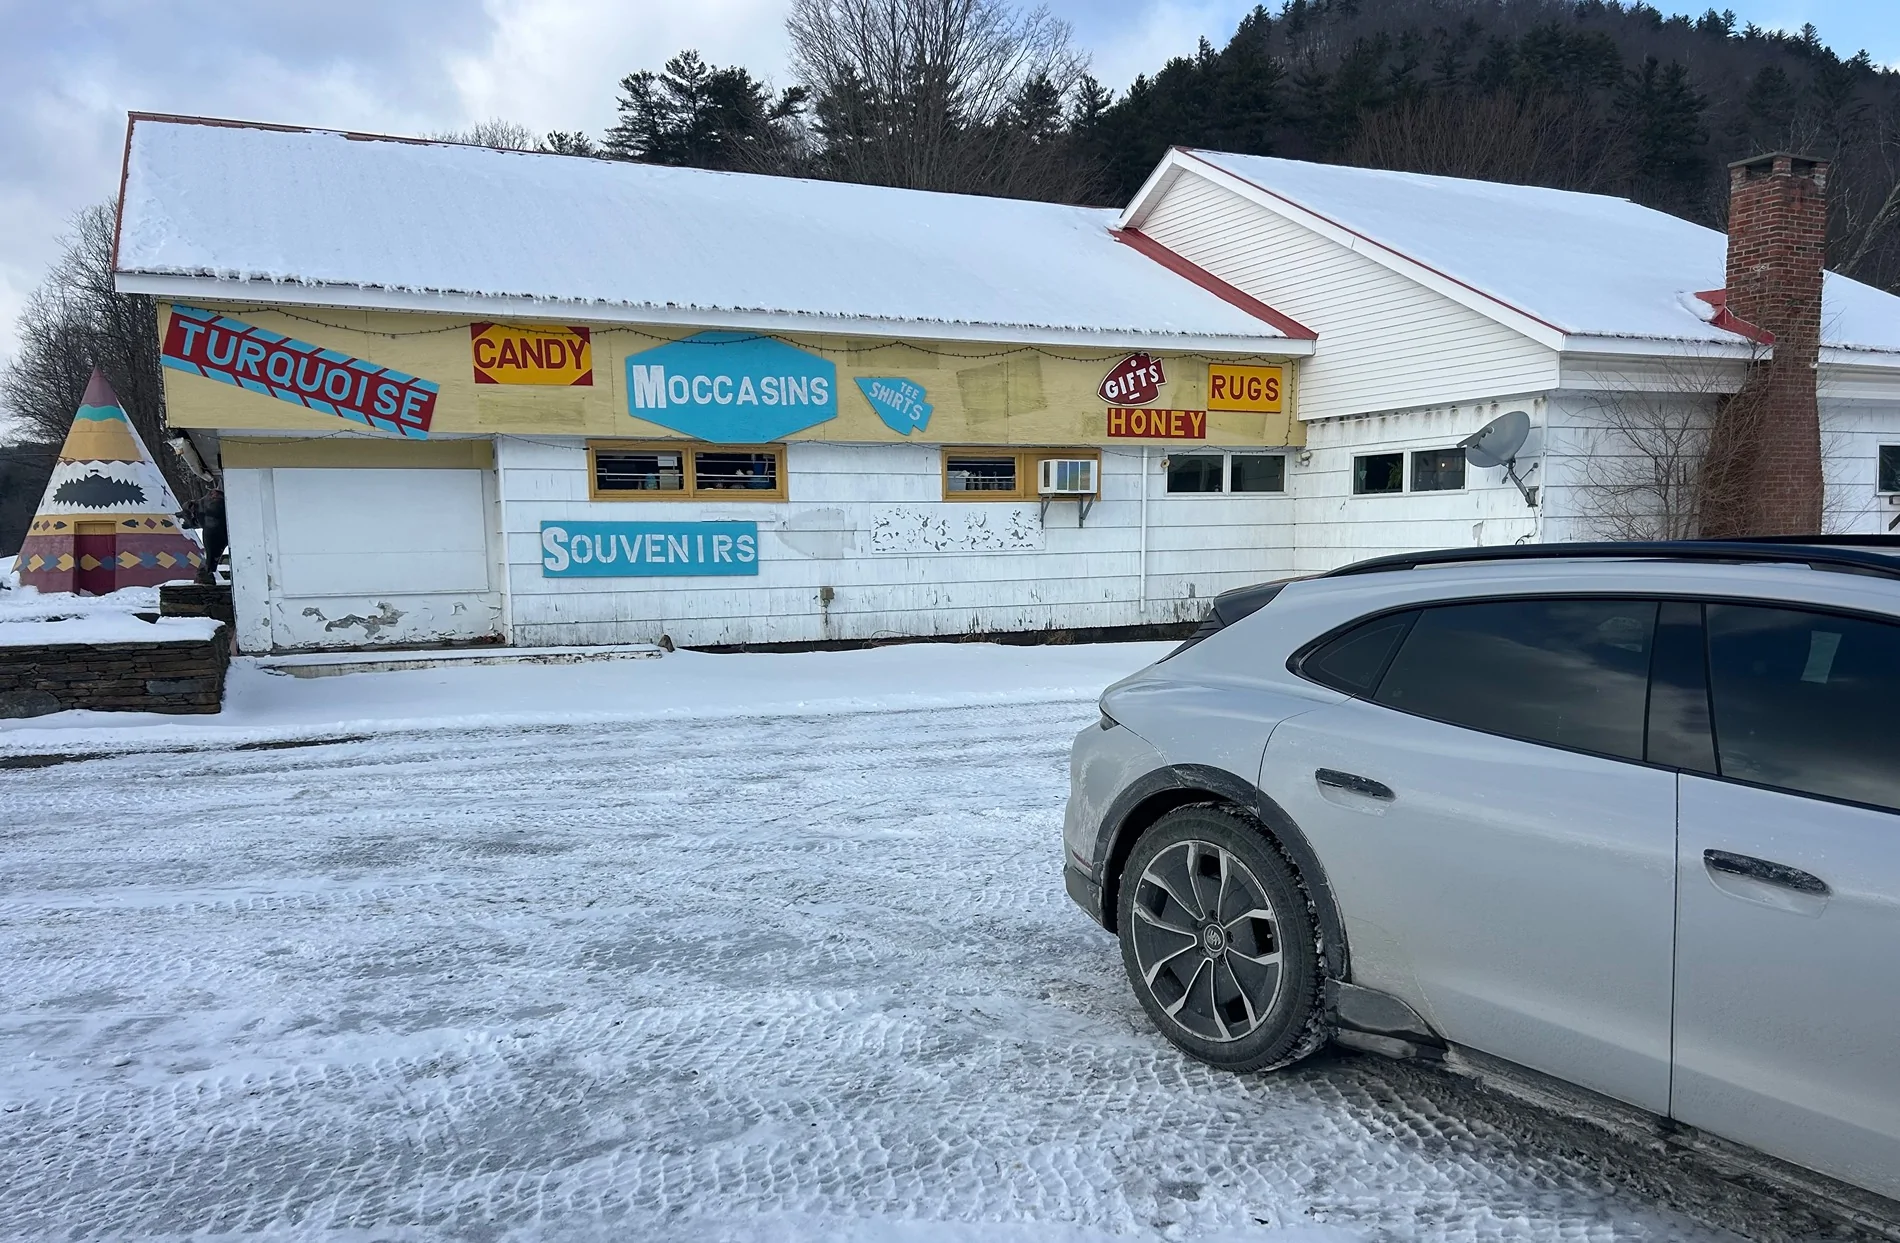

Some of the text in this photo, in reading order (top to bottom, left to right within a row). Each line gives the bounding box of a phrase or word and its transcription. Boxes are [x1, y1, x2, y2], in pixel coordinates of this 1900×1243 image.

[474, 337, 587, 370] CANDY
[179, 320, 429, 424] TURQUOISE
[632, 365, 829, 408] MOCCASINS
[1105, 365, 1159, 399] GIFTS
[1211, 375, 1279, 401] RUGS
[870, 382, 923, 420] SHIRTS
[901, 382, 919, 399] TEE
[1110, 409, 1203, 437] HONEY
[542, 526, 756, 572] SOUVENIRS
